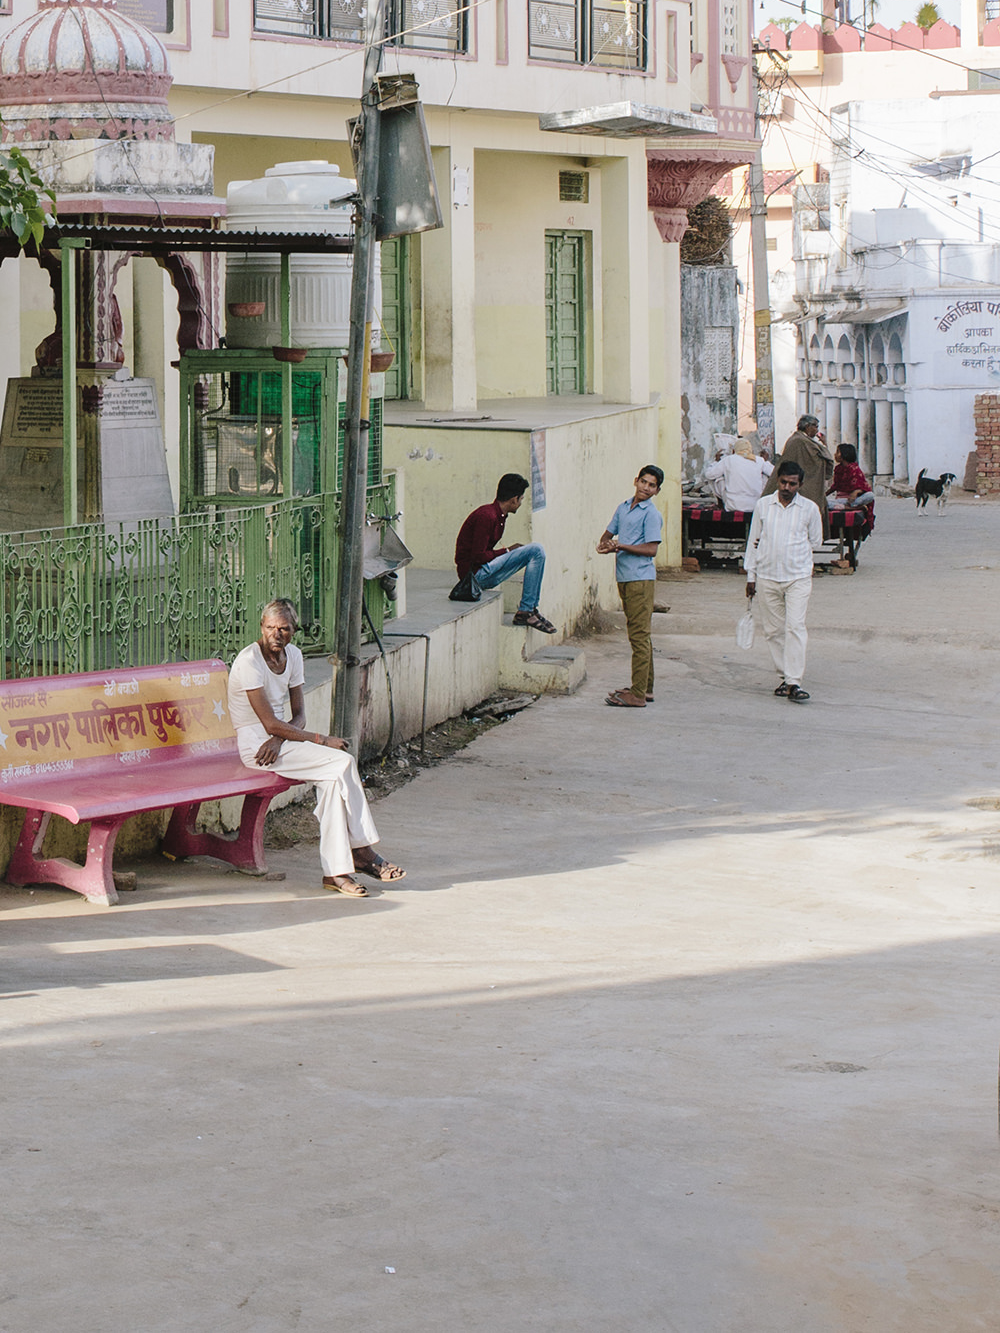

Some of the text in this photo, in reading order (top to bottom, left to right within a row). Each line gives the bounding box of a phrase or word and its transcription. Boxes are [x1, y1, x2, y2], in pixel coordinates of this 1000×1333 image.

[963, 327, 994, 338] आपका
[961, 359, 985, 368] करता
[8, 697, 208, 751] नगर पालिका पुष्कर
